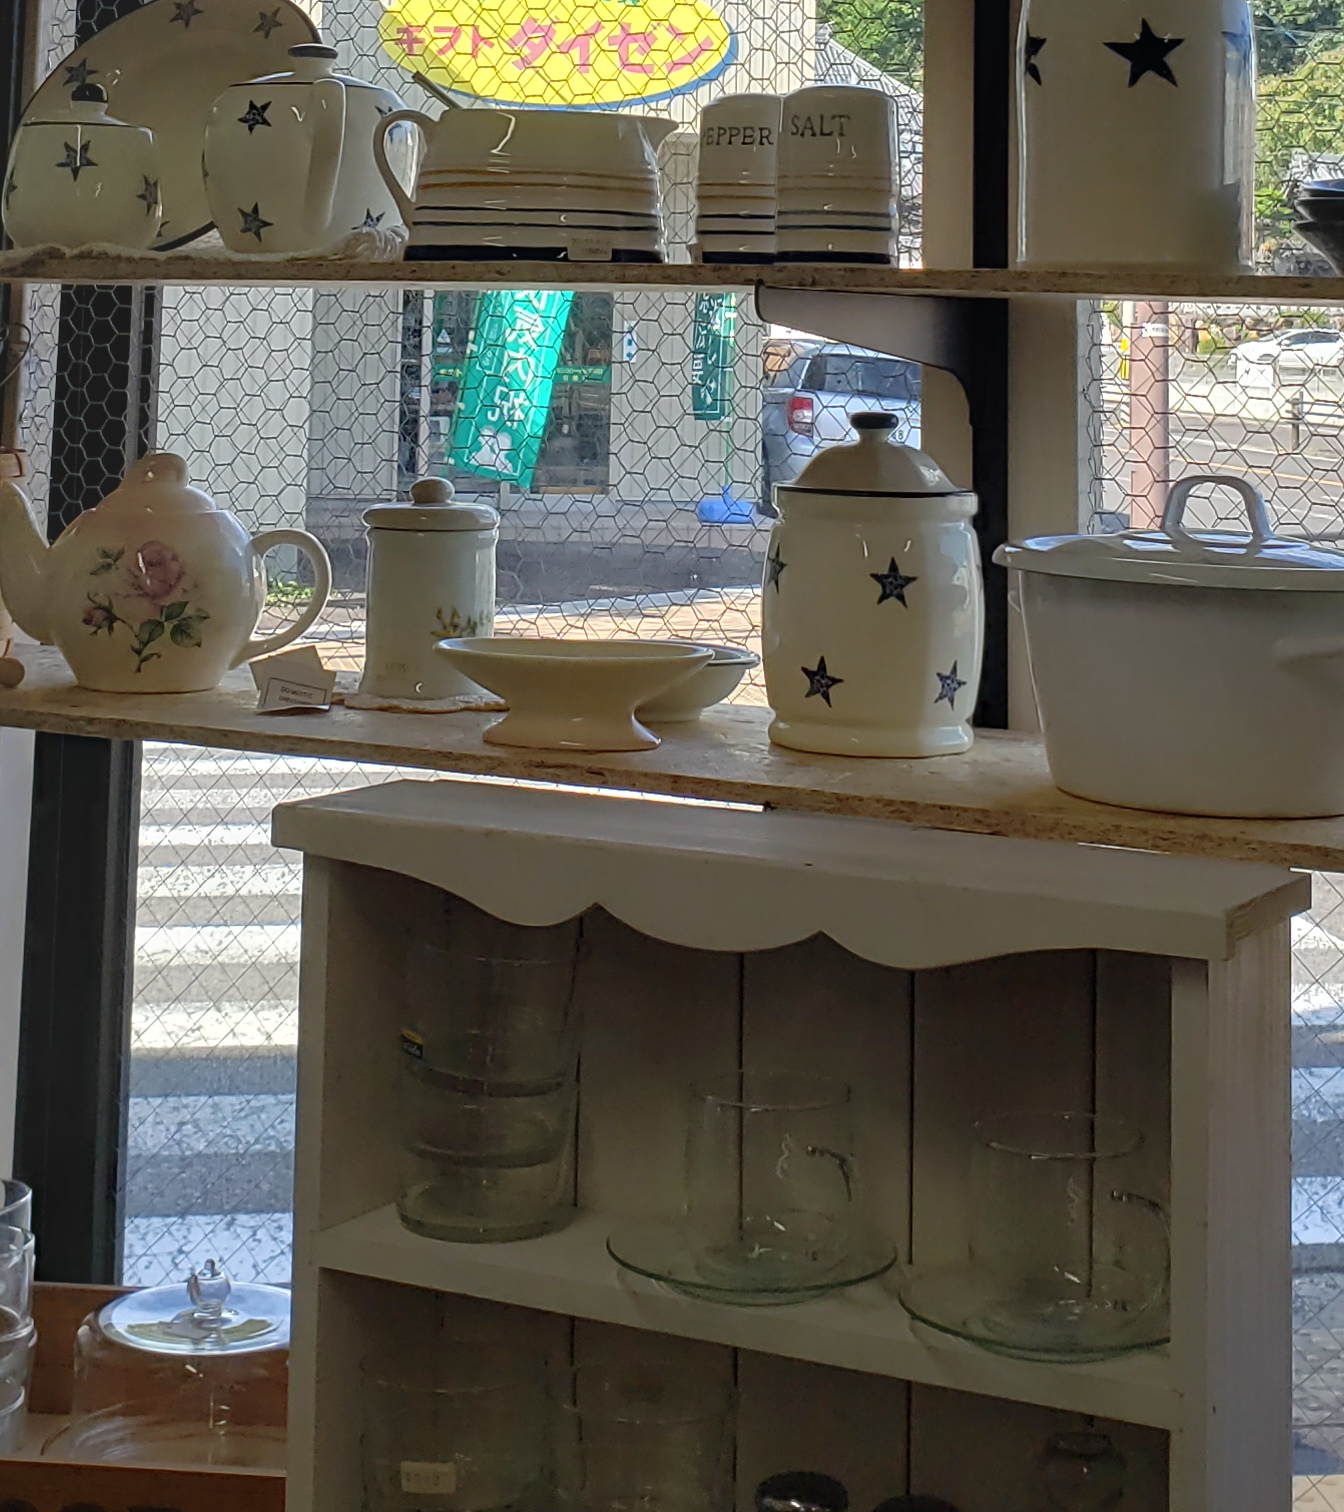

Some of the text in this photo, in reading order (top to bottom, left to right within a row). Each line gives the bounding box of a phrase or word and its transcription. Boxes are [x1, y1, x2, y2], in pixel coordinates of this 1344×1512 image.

[394, 16, 714, 74] ギフト ダイゼン
[790, 114, 851, 138] SALT
